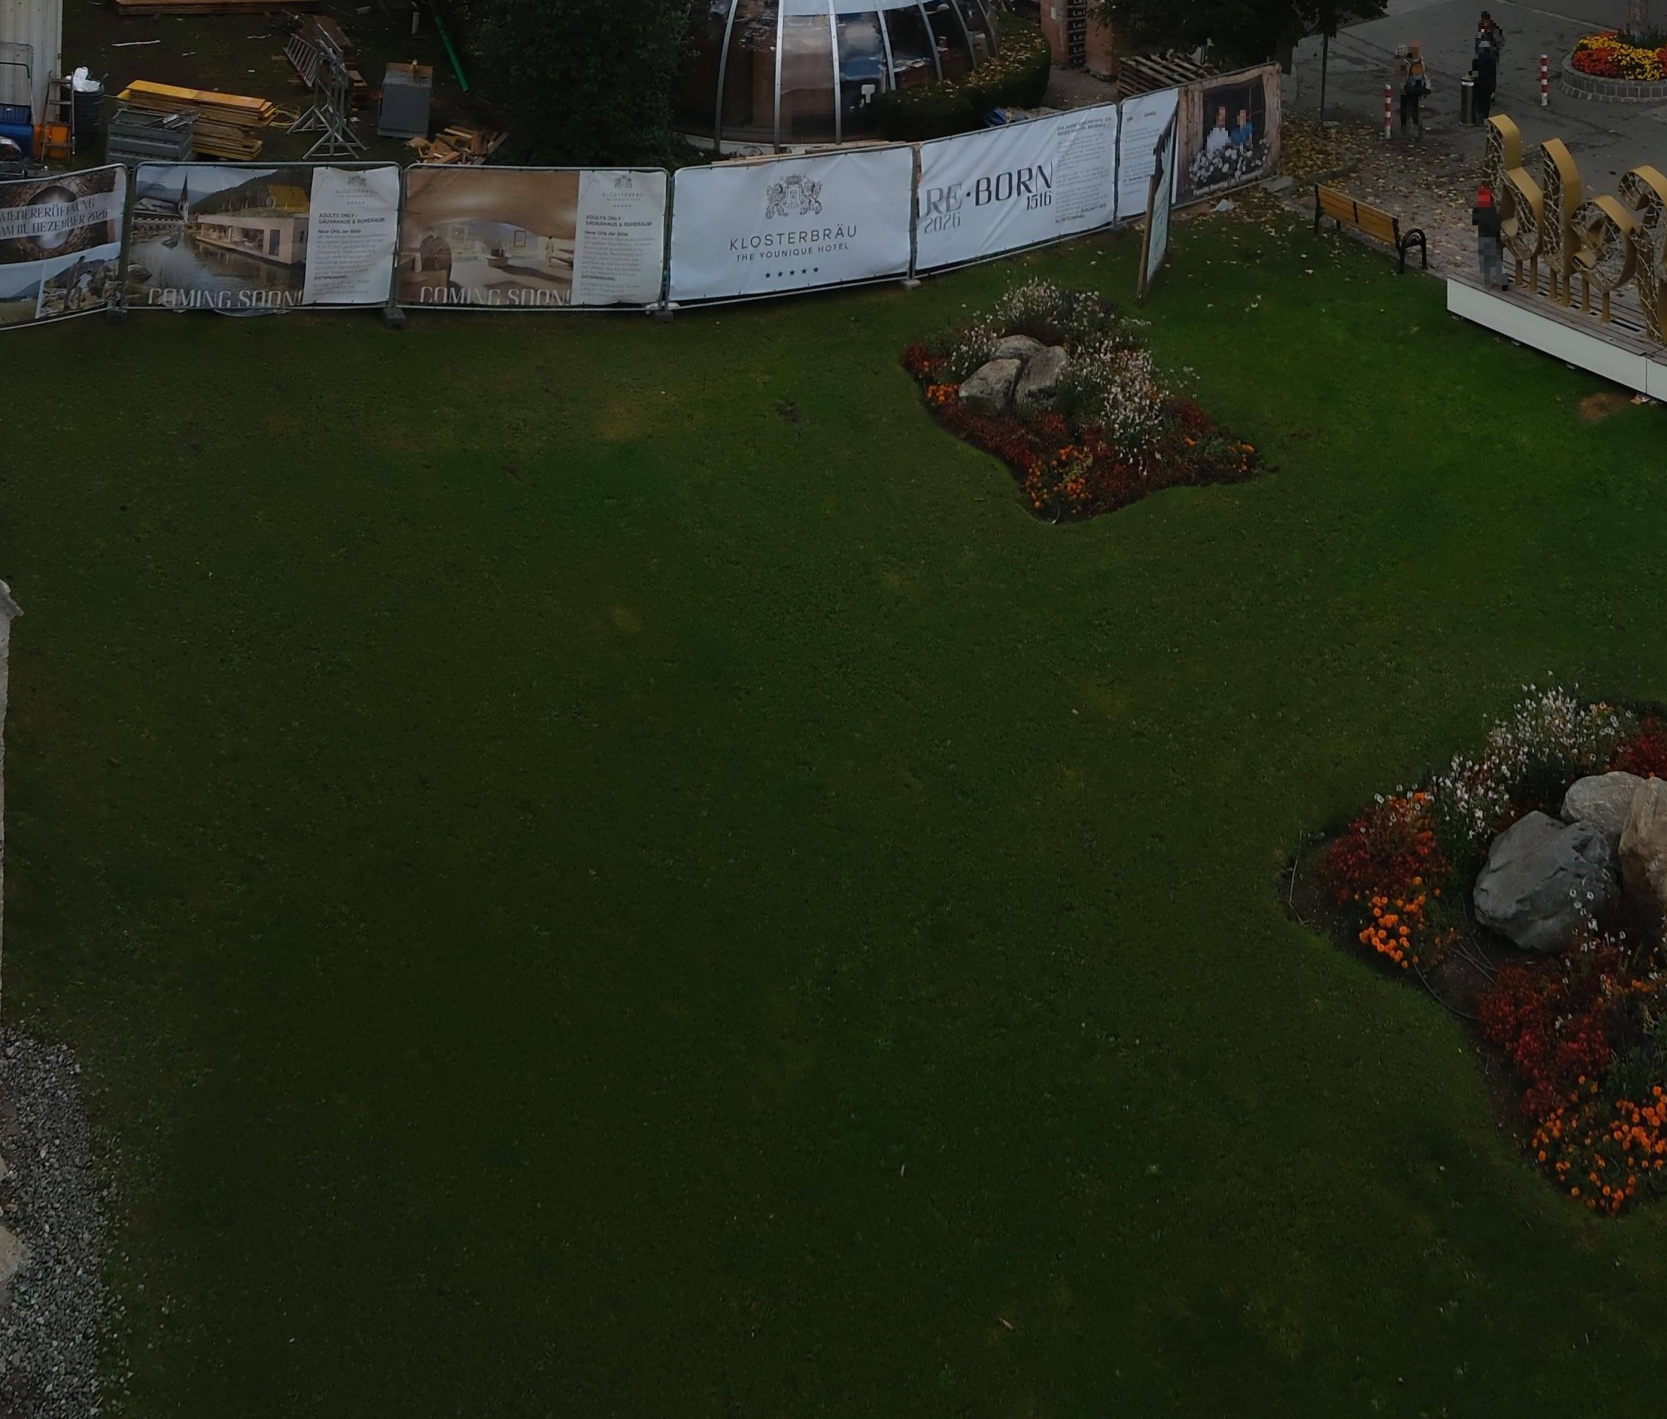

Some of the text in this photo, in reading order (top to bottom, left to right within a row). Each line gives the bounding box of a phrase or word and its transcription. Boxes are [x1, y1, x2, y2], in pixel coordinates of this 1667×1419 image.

[1026, 191, 1052, 211] 1516
[32, 213, 85, 233] DEZEMBER
[924, 213, 961, 233] 2026
[729, 224, 857, 251] KLOSTERBRÄU
[736, 242, 849, 261] THE YOUNIQUE HOTEL
[149, 287, 303, 308] COMING SOON!
[420, 286, 501, 305] COMING
[508, 289, 570, 305] SOON!
